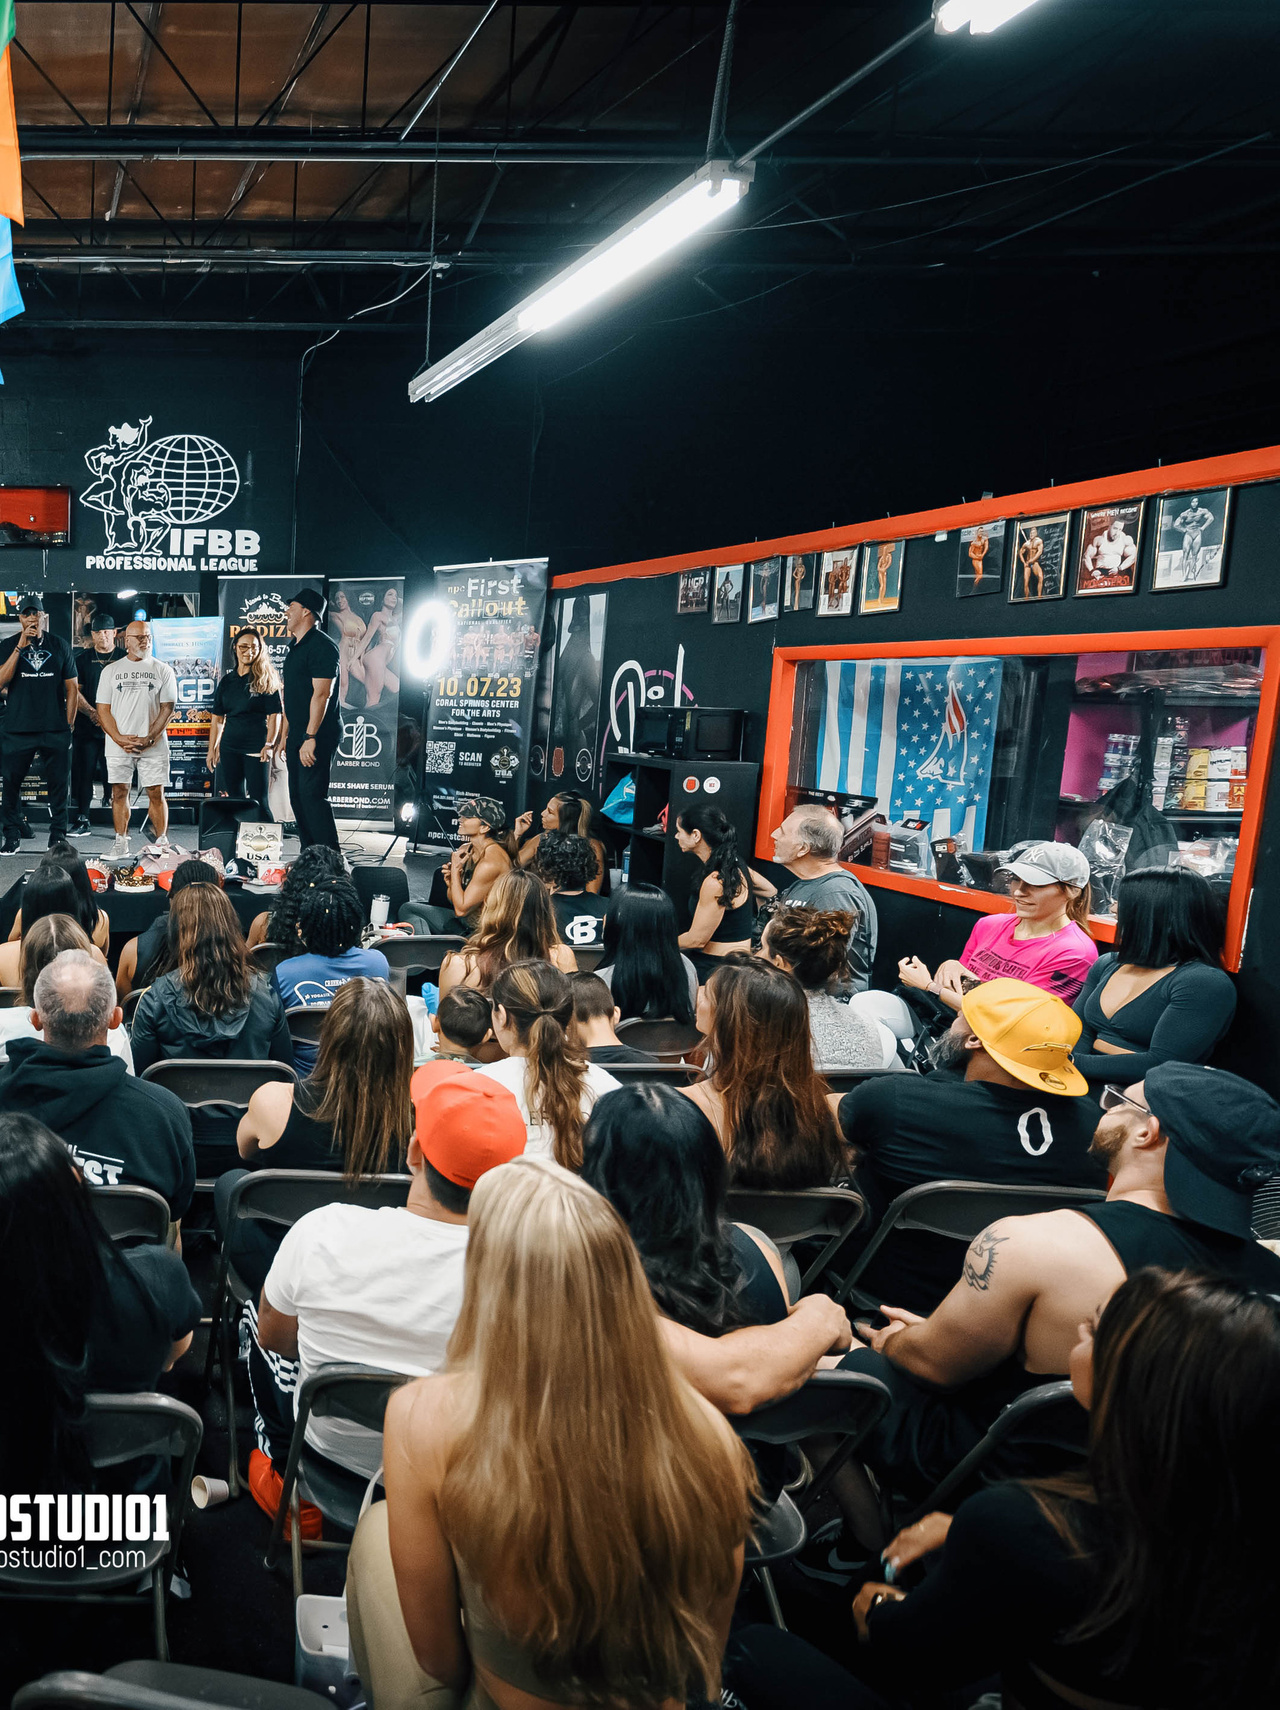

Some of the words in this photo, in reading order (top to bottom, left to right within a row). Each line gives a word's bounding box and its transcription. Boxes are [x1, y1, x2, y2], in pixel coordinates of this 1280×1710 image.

[1107, 508, 1119, 517] MEN
[170, 529, 261, 556] IFBB
[86, 556, 196, 571] PROFESSIONAL
[200, 557, 258, 572] LEAGUE
[467, 575, 524, 598] First
[131, 672, 156, 680] SCHOOL
[438, 677, 522, 697] 10.07.23
[435, 698, 458, 707] CORAL
[459, 699, 490, 708] SPRINGS
[491, 700, 520, 708] CENTER
[467, 709, 480, 717] THE
[459, 752, 482, 762] SCAN
